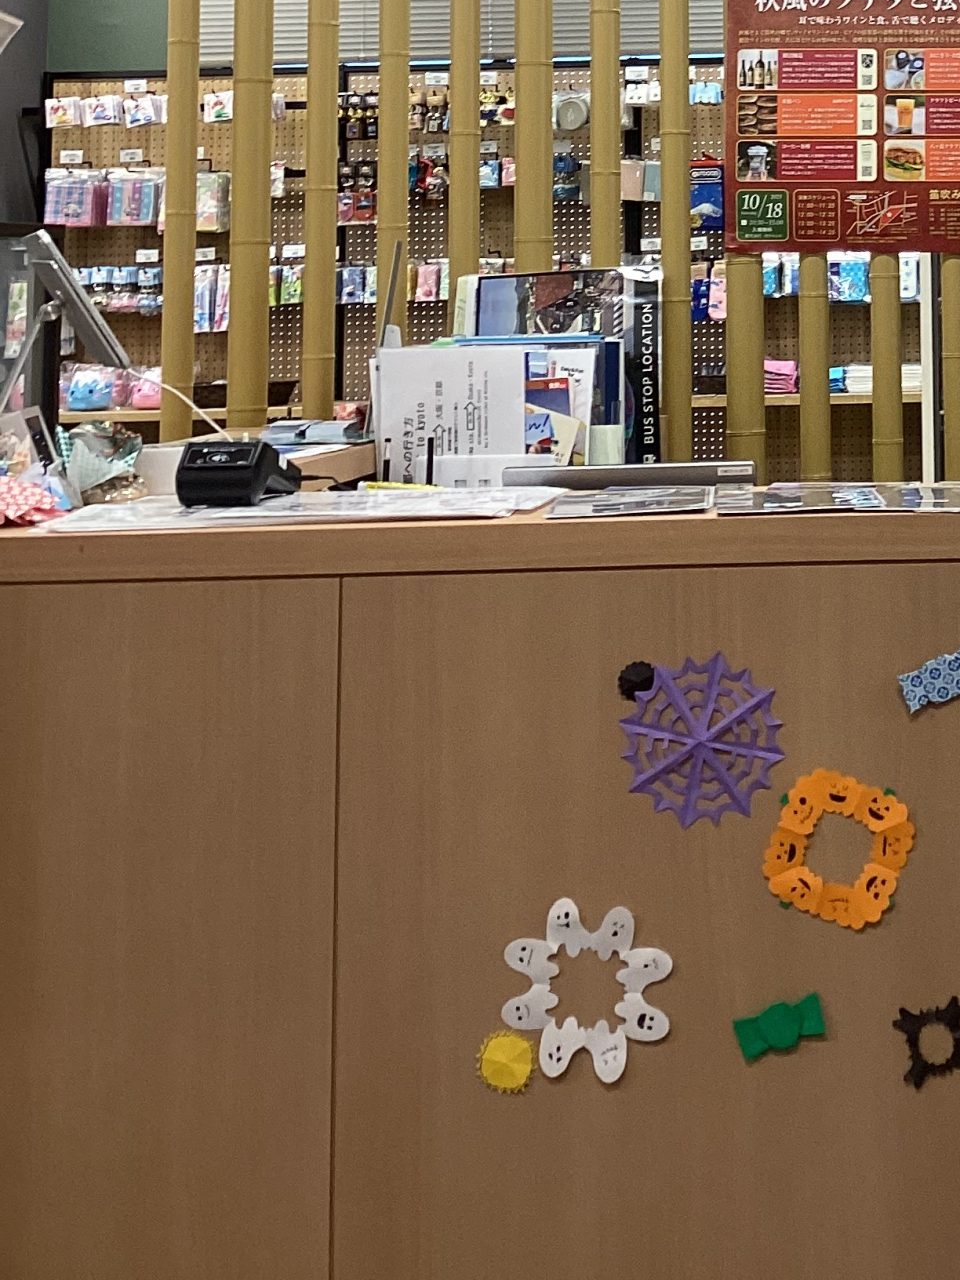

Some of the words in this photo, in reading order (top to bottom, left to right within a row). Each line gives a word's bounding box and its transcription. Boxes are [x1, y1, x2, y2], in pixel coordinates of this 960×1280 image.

[641, 303, 654, 372] LOCATION
[642, 376, 654, 413] STOP
[415, 402, 426, 431] kyoto
[643, 417, 655, 444] BUS
